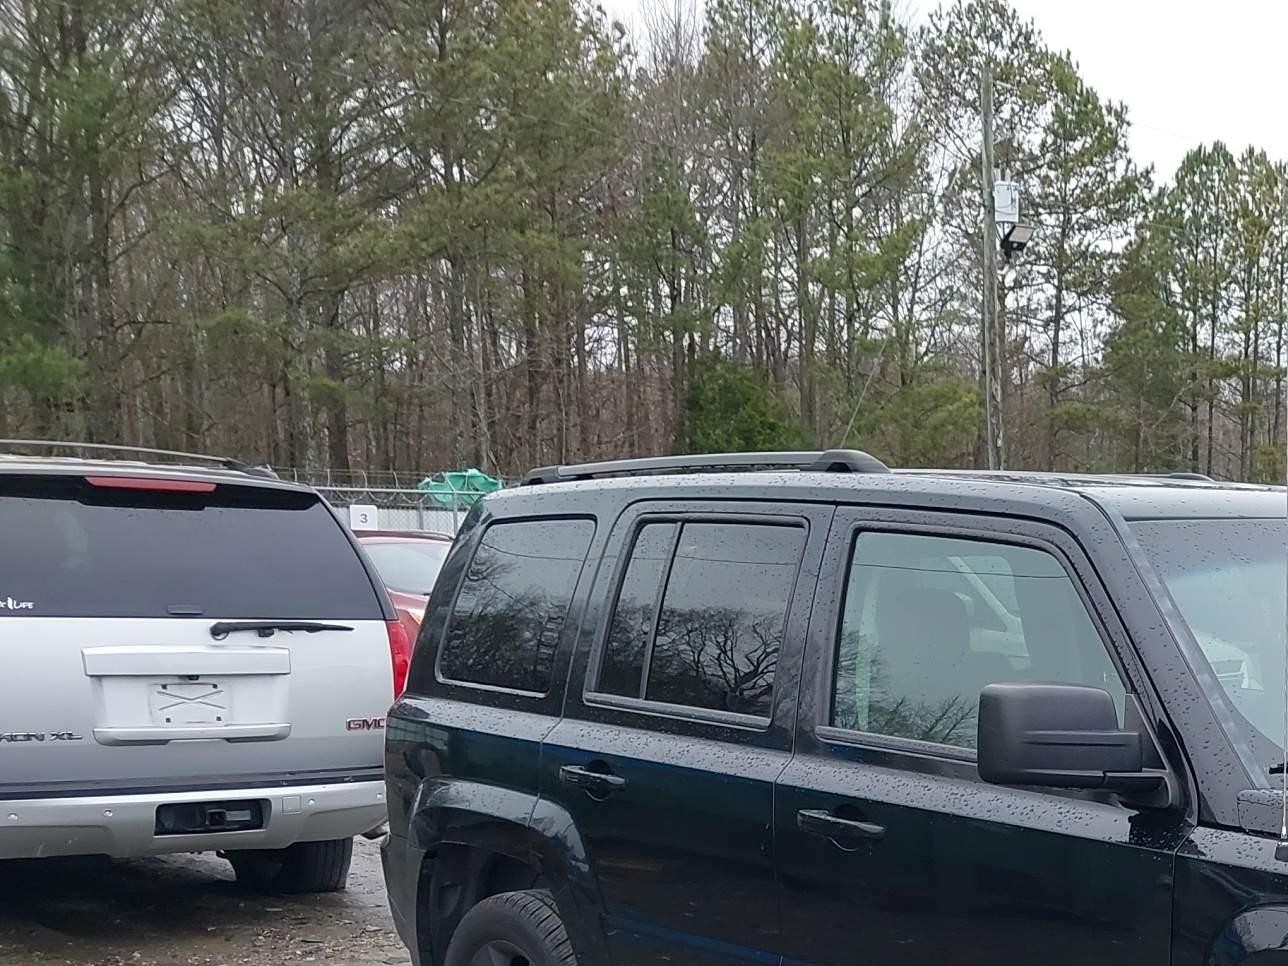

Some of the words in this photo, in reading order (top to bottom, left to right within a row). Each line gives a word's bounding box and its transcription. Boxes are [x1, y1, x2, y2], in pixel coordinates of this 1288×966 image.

[360, 513, 368, 524] 3
[346, 718, 385, 731] GMC
[49, 731, 83, 741] XL
